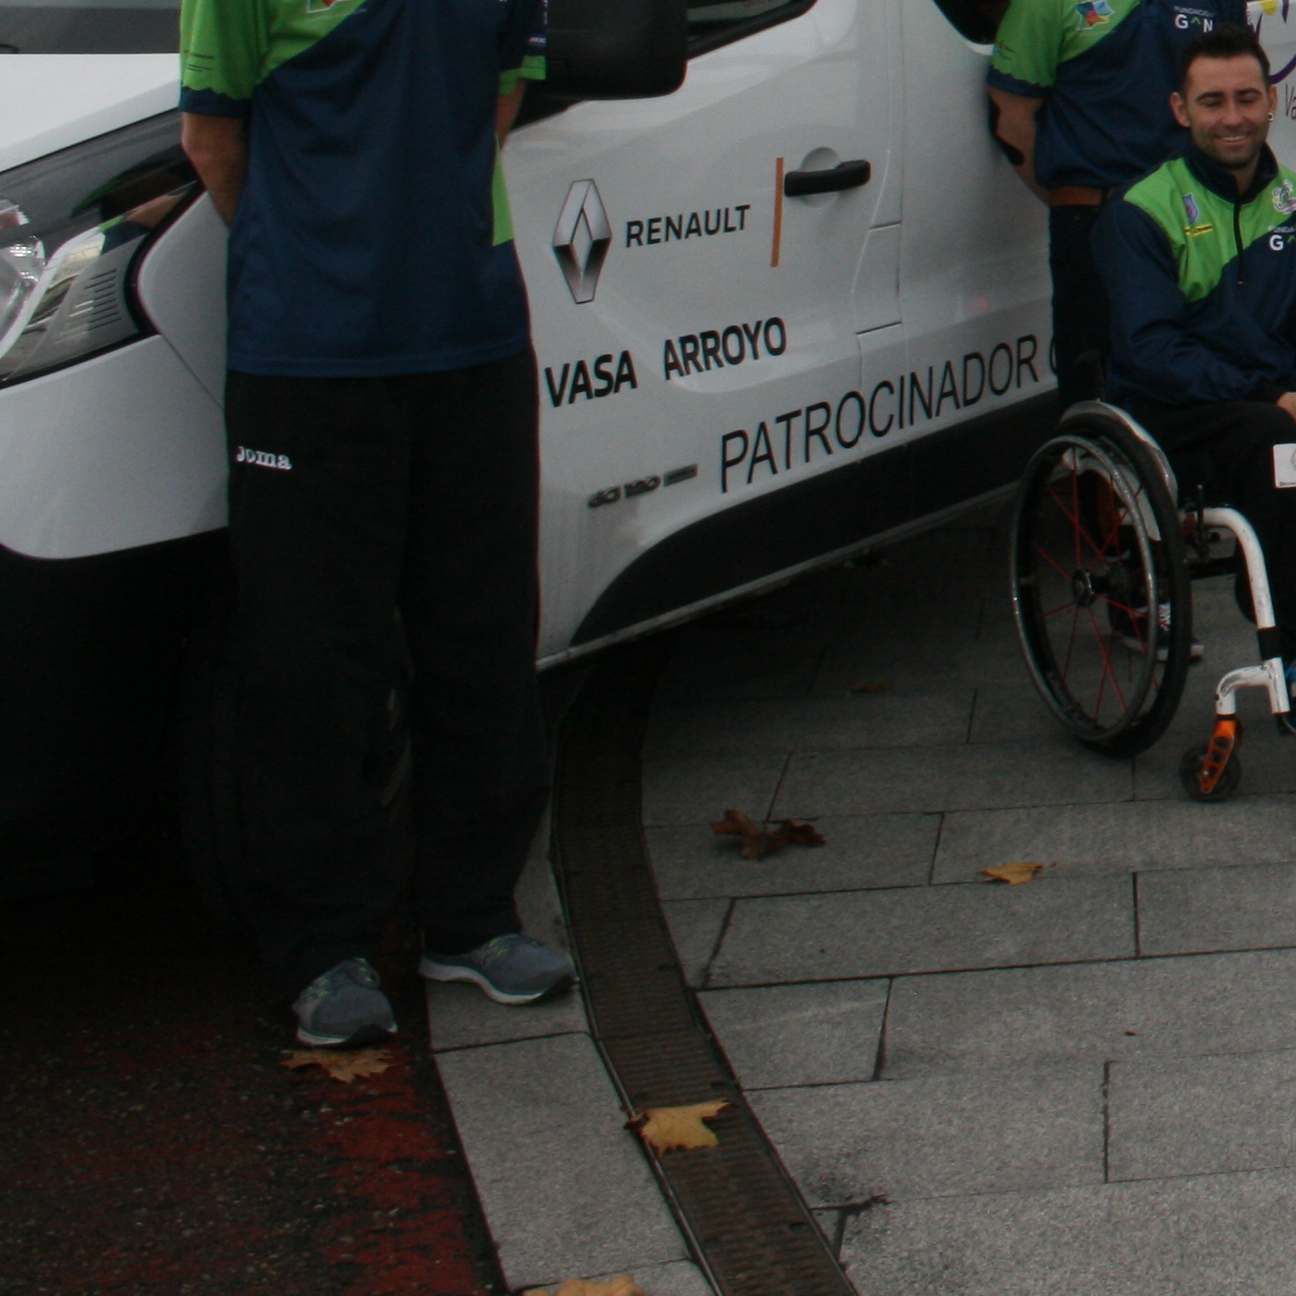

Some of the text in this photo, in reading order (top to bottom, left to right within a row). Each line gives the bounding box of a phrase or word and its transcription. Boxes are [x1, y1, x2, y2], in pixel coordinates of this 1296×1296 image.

[625, 205, 751, 248] RENAULT
[544, 316, 787, 408] VASA ARROYO
[720, 333, 1038, 494] PATROCINADOR
